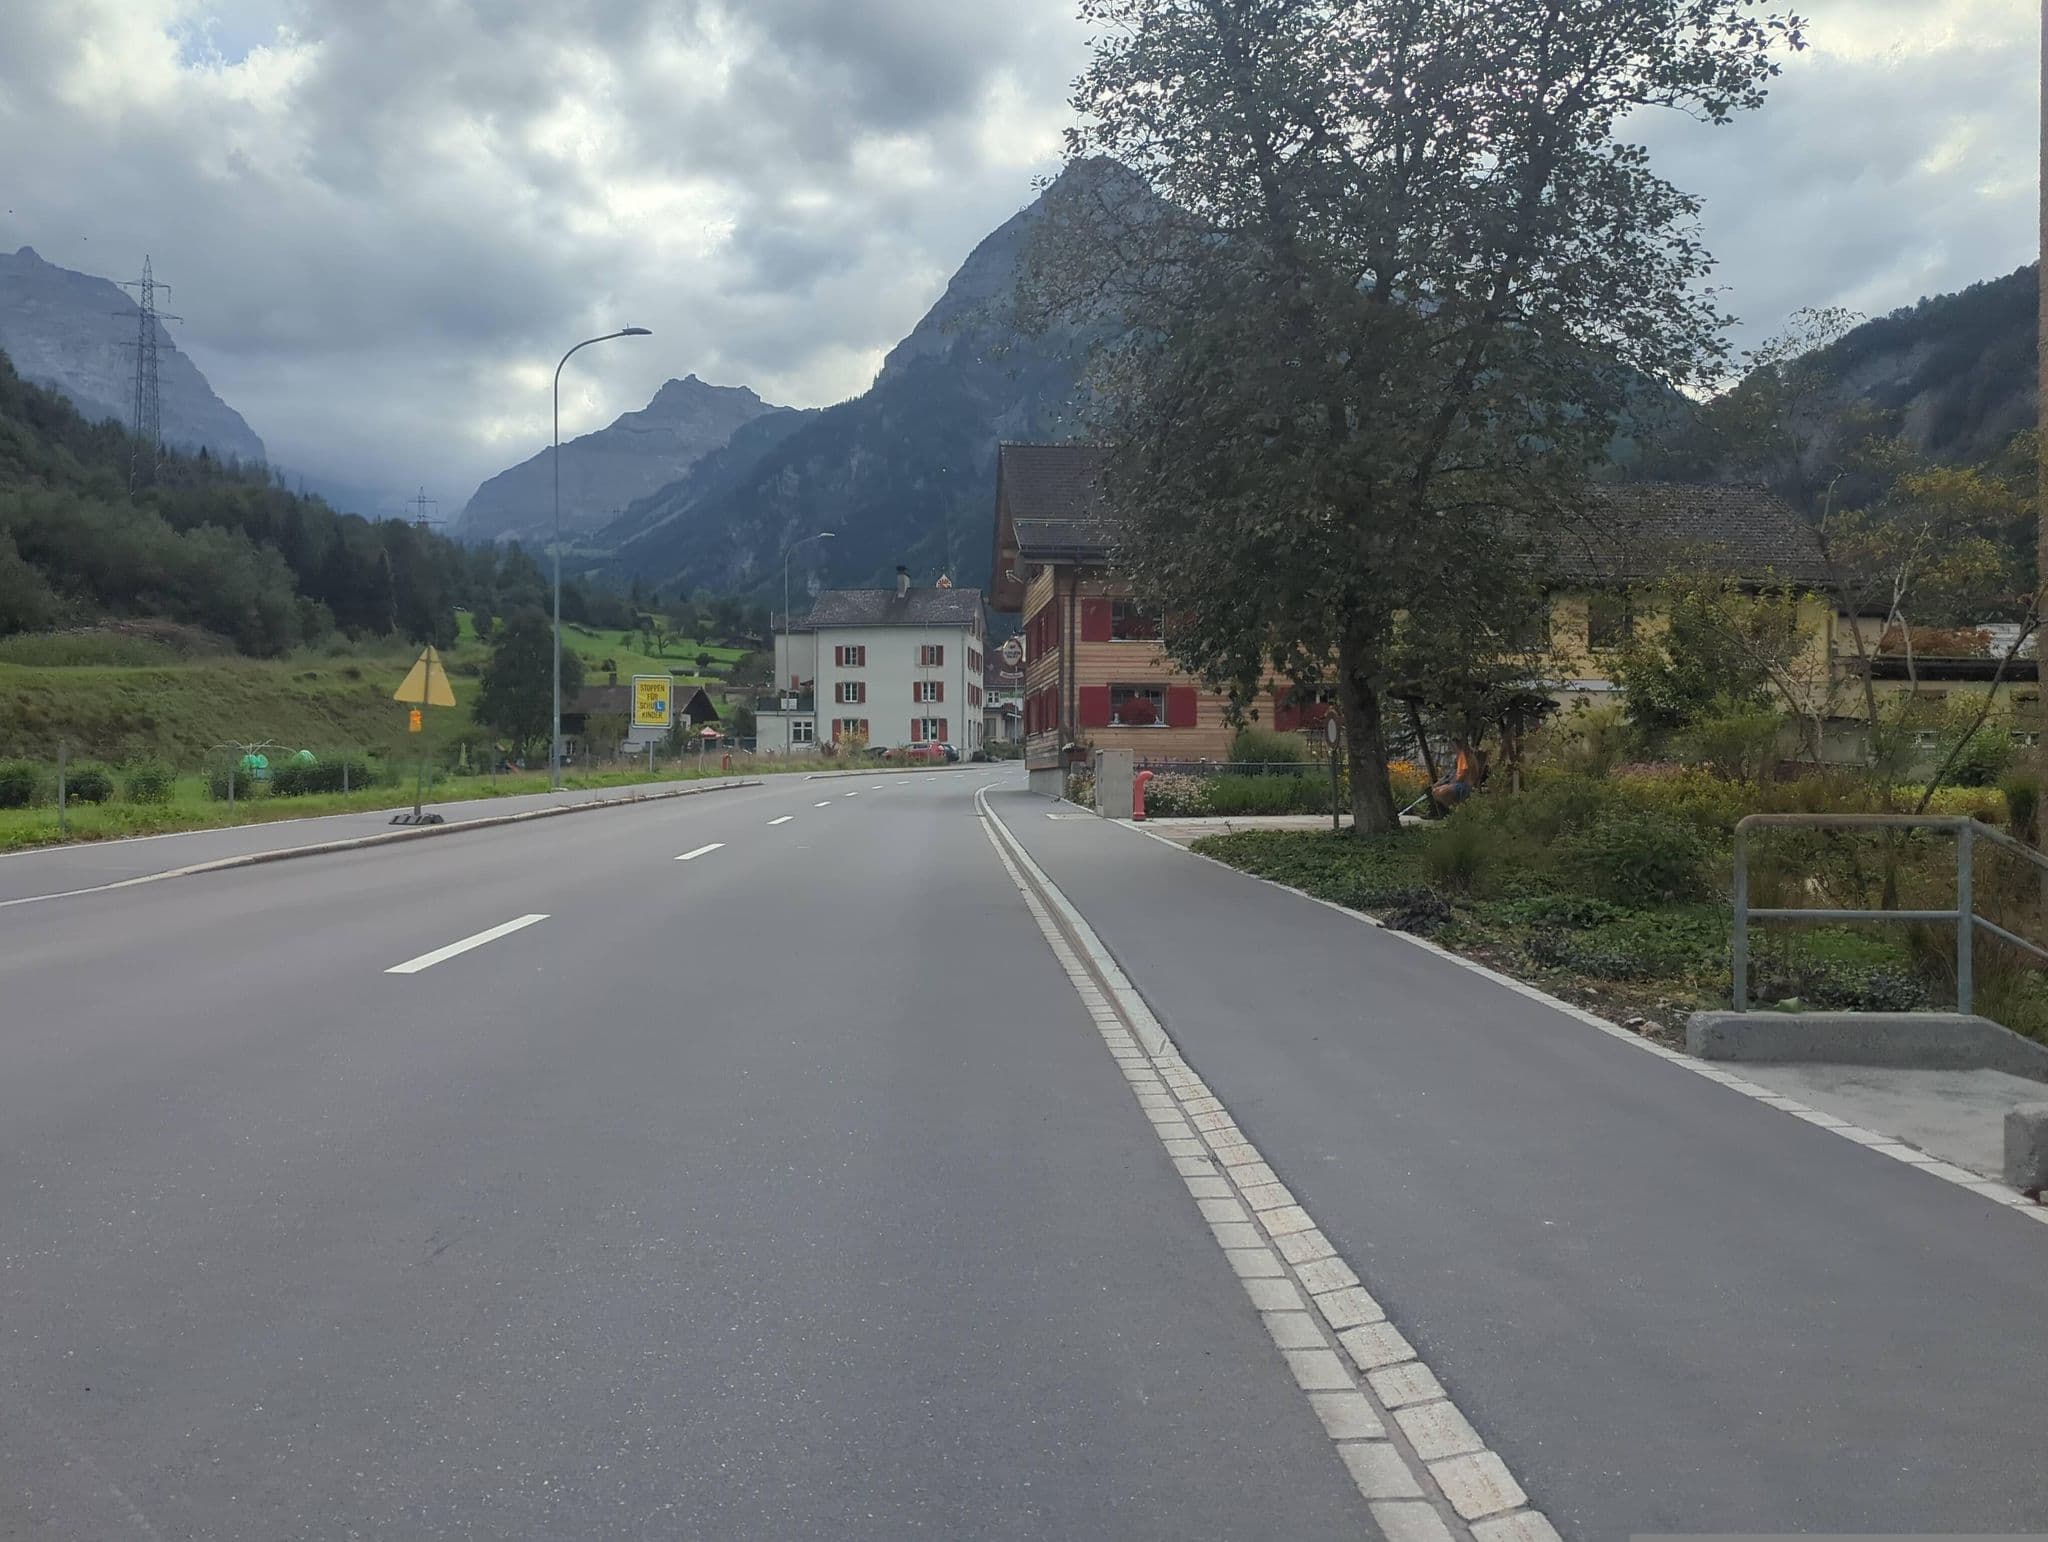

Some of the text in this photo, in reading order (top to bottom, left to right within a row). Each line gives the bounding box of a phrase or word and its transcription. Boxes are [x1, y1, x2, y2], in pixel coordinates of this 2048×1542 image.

[640, 684, 665, 692] STOPPEN
[647, 693, 658, 701] FÜR
[641, 711, 663, 719] KINDER
